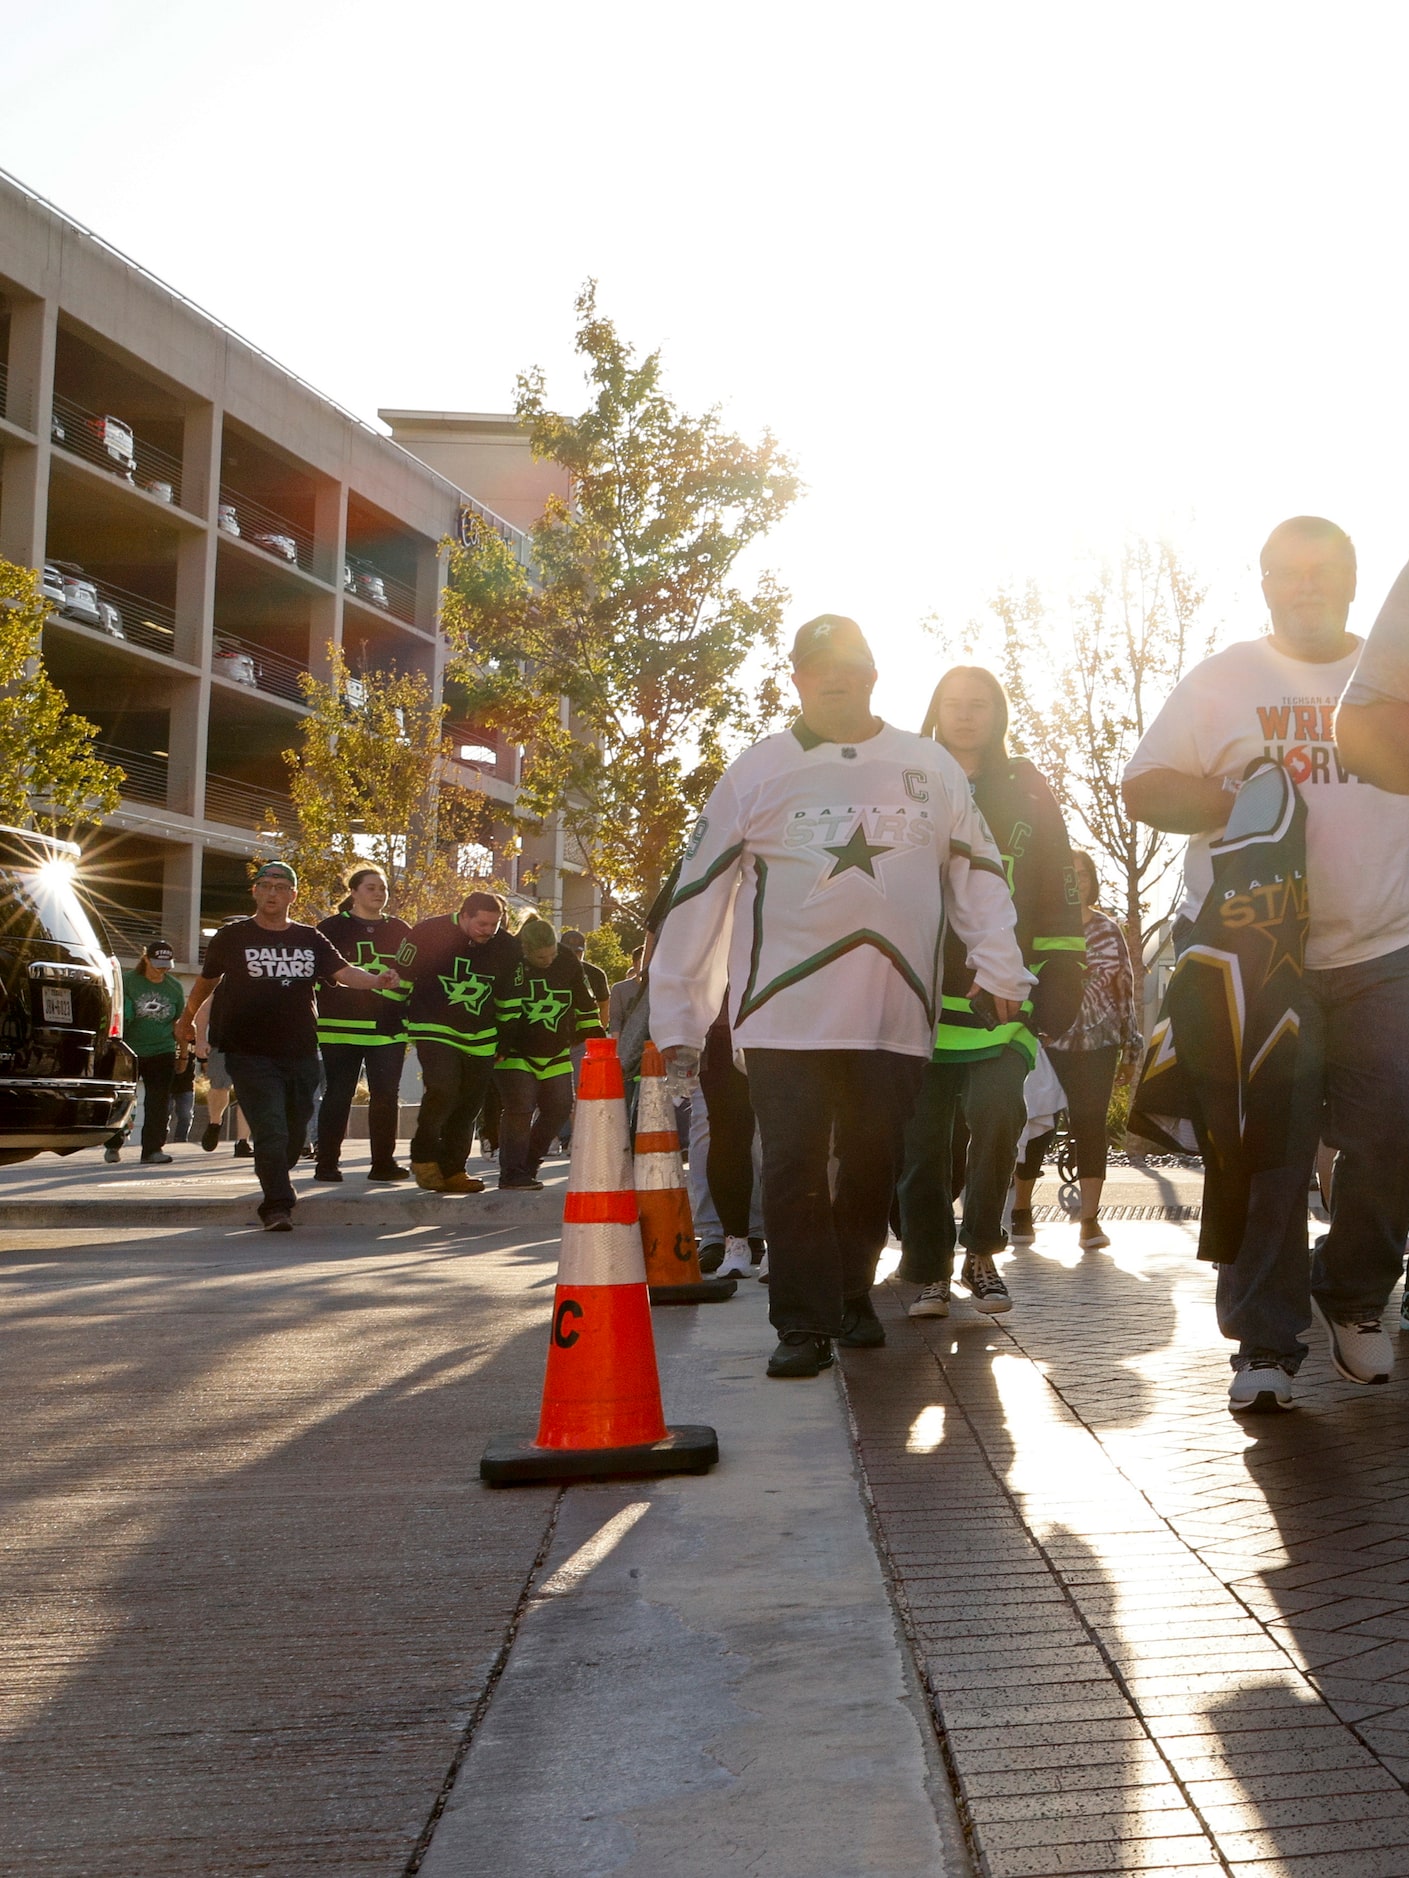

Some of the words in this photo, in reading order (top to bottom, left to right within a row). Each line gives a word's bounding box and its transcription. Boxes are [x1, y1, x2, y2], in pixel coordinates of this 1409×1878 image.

[902, 768, 929, 804] C
[783, 808, 935, 848] STARS
[794, 806, 929, 819] DALLAS
[1007, 821, 1033, 858] C
[244, 948, 316, 962] DALLAS
[247, 960, 315, 978] STARS
[551, 1299, 584, 1349] C
